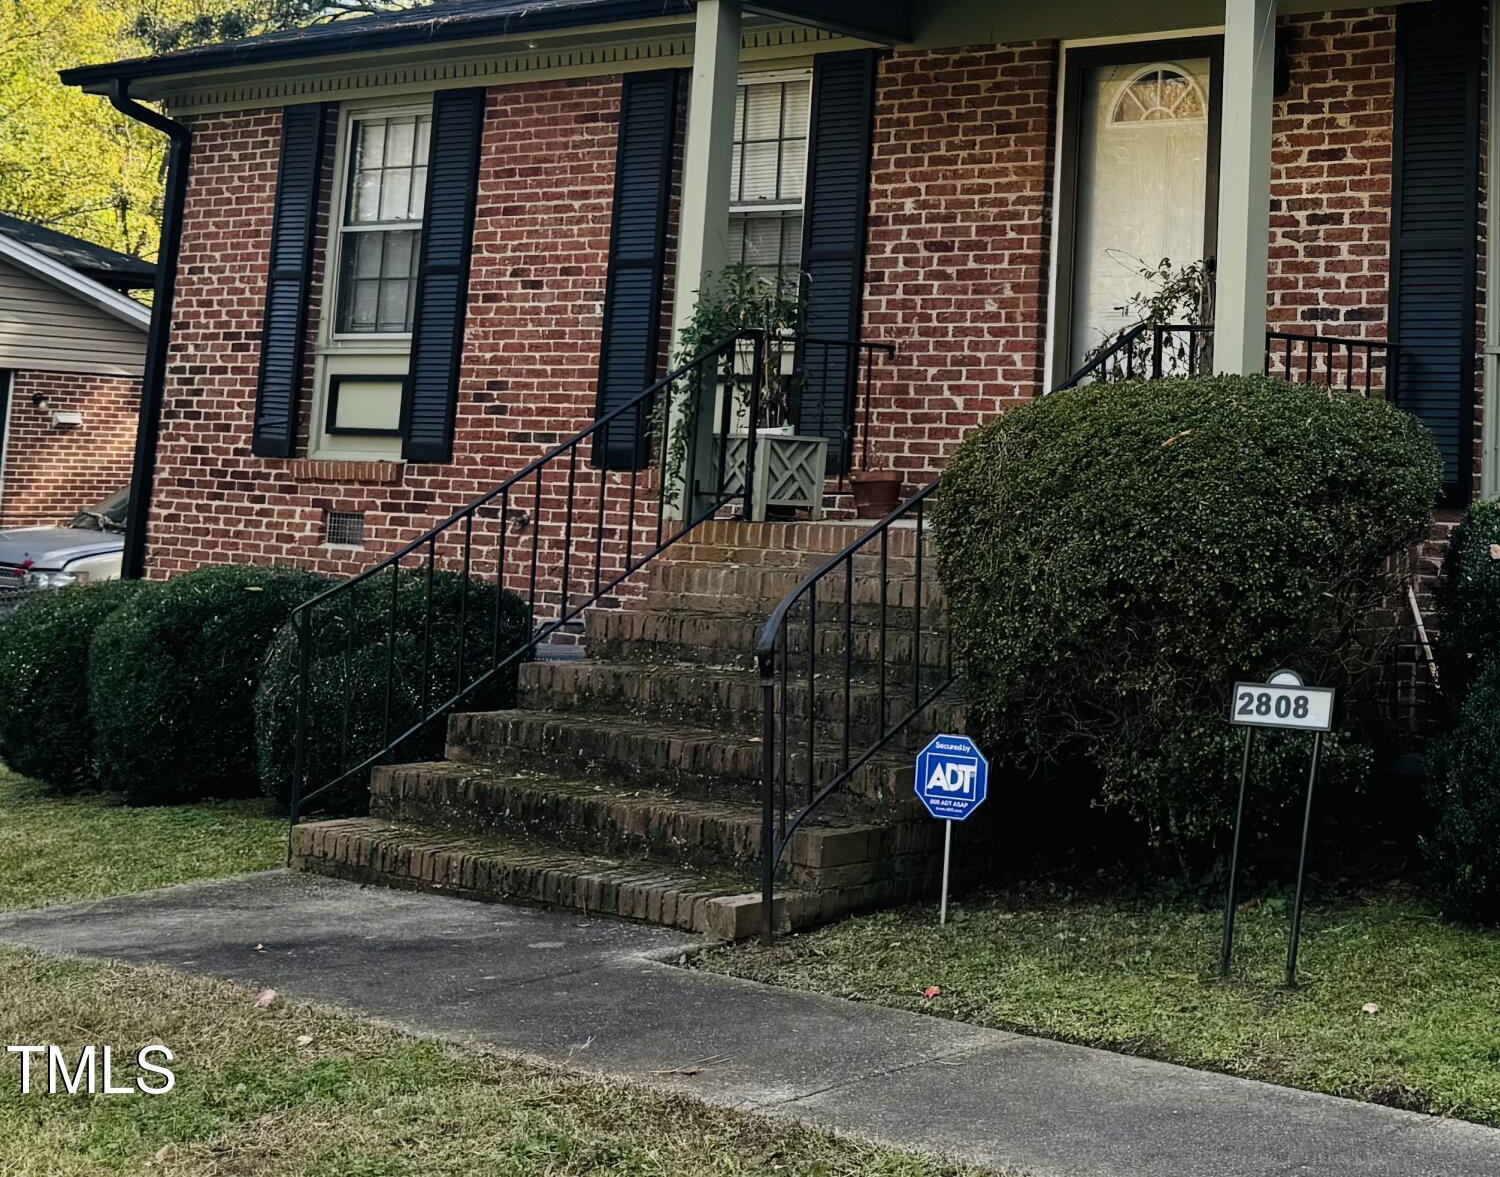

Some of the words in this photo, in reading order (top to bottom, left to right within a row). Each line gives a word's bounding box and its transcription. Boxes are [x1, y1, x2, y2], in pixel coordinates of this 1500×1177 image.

[1237, 692, 1309, 719] 2808
[935, 741, 962, 750] Secured
[962, 744, 970, 753] by
[927, 762, 976, 793] ADT
